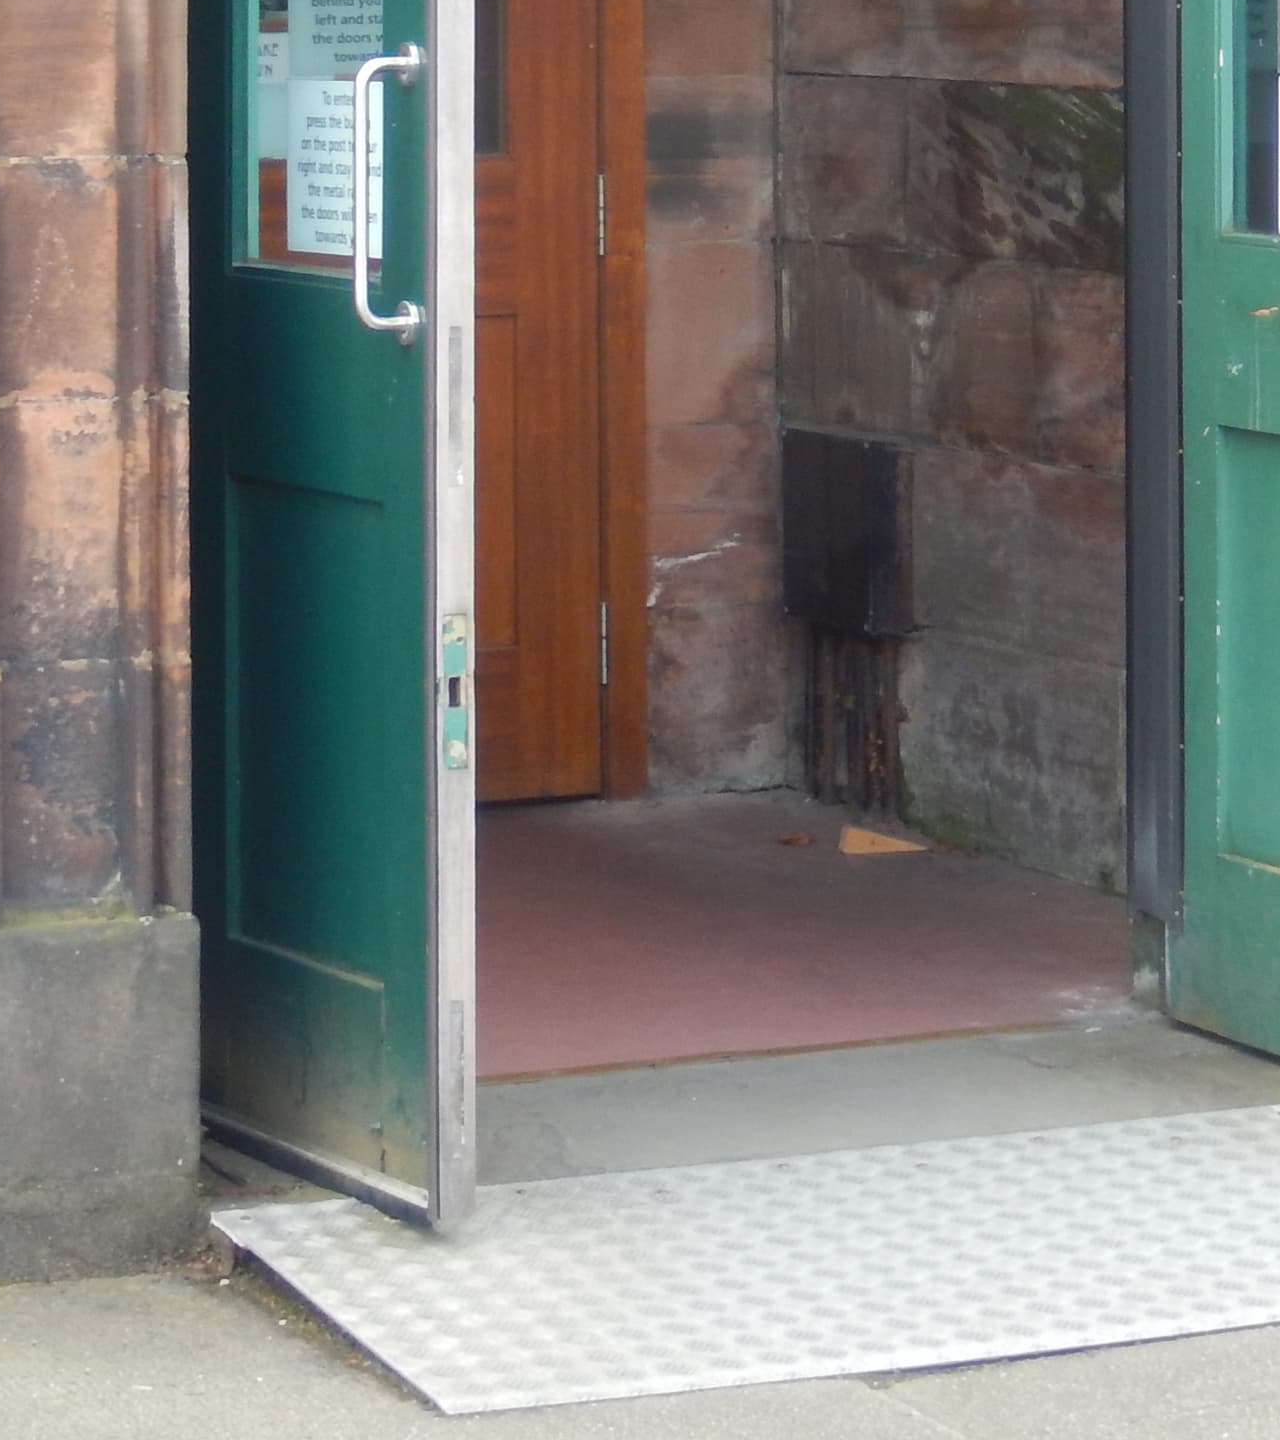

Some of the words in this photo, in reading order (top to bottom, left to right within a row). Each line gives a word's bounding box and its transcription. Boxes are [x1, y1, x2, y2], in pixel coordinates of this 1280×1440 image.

[314, 14, 337, 25] left
[341, 14, 364, 25] and
[312, 34, 332, 44] the
[337, 32, 371, 44] doors
[307, 116, 327, 130] press
[329, 114, 342, 128] the
[314, 137, 326, 150] the
[318, 161, 333, 174] and
[308, 184, 321, 197] the
[301, 204, 315, 219] the
